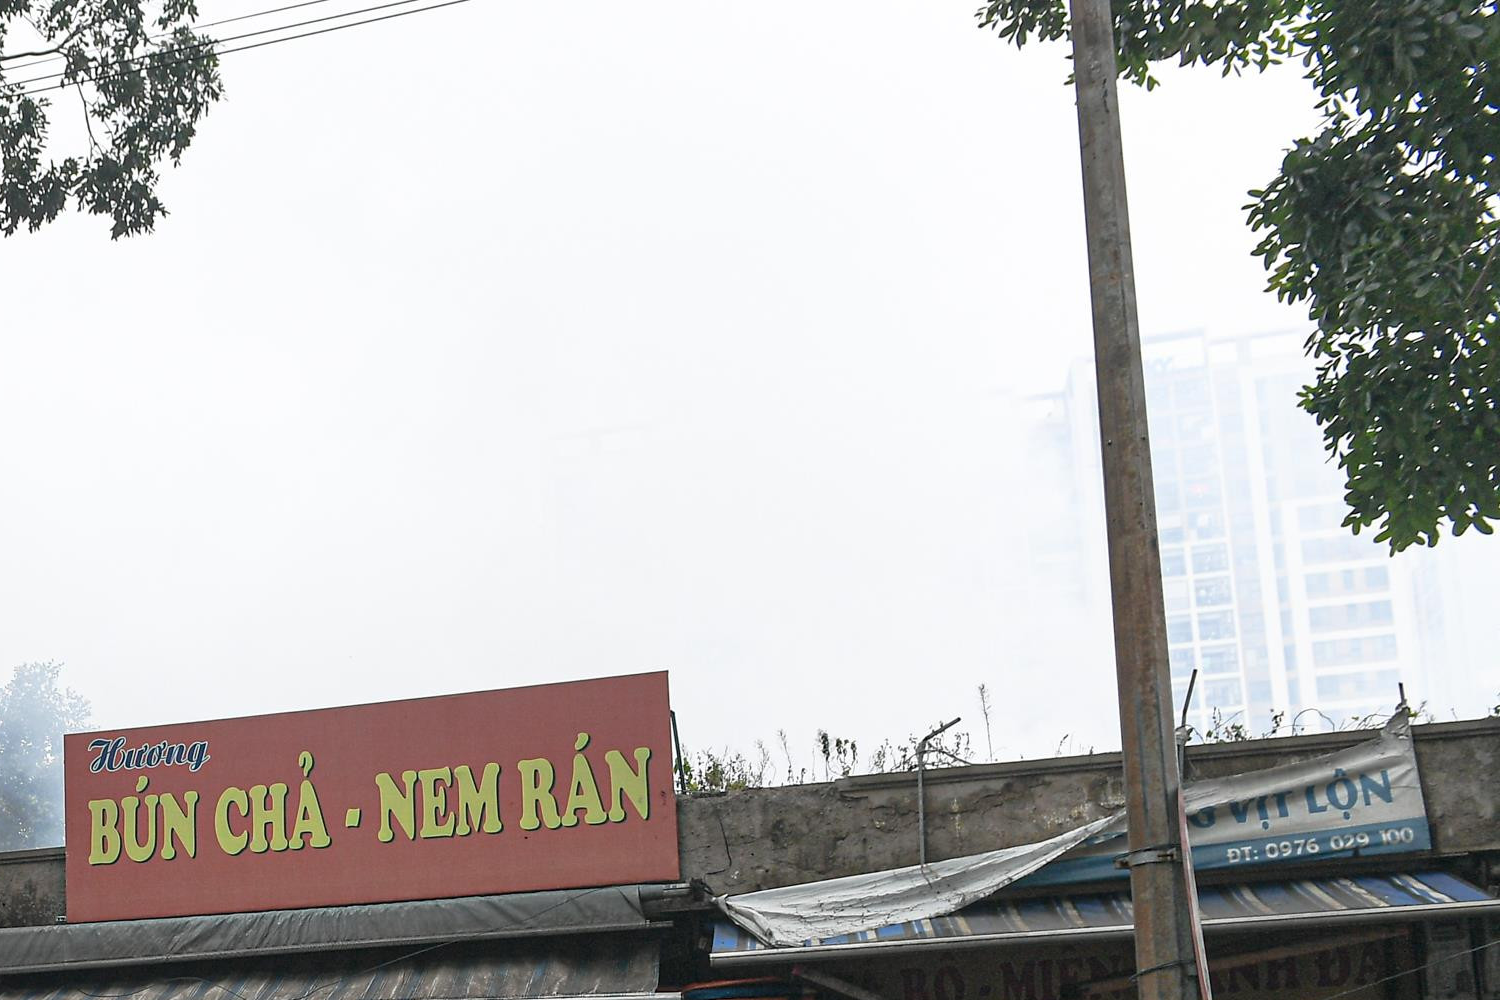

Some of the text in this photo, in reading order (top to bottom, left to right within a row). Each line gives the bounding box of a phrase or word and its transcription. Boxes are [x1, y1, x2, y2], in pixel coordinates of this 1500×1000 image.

[88, 736, 211, 774] Hương
[88, 775, 199, 865] BÚN
[215, 751, 332, 856] CHẢ
[375, 762, 503, 842] NEM
[517, 732, 652, 830] RÁN
[1305, 768, 1395, 821] LỘN
[1265, 838, 1320, 860] 0976
[1329, 832, 1370, 850] 029
[1379, 826, 1415, 844] 100
